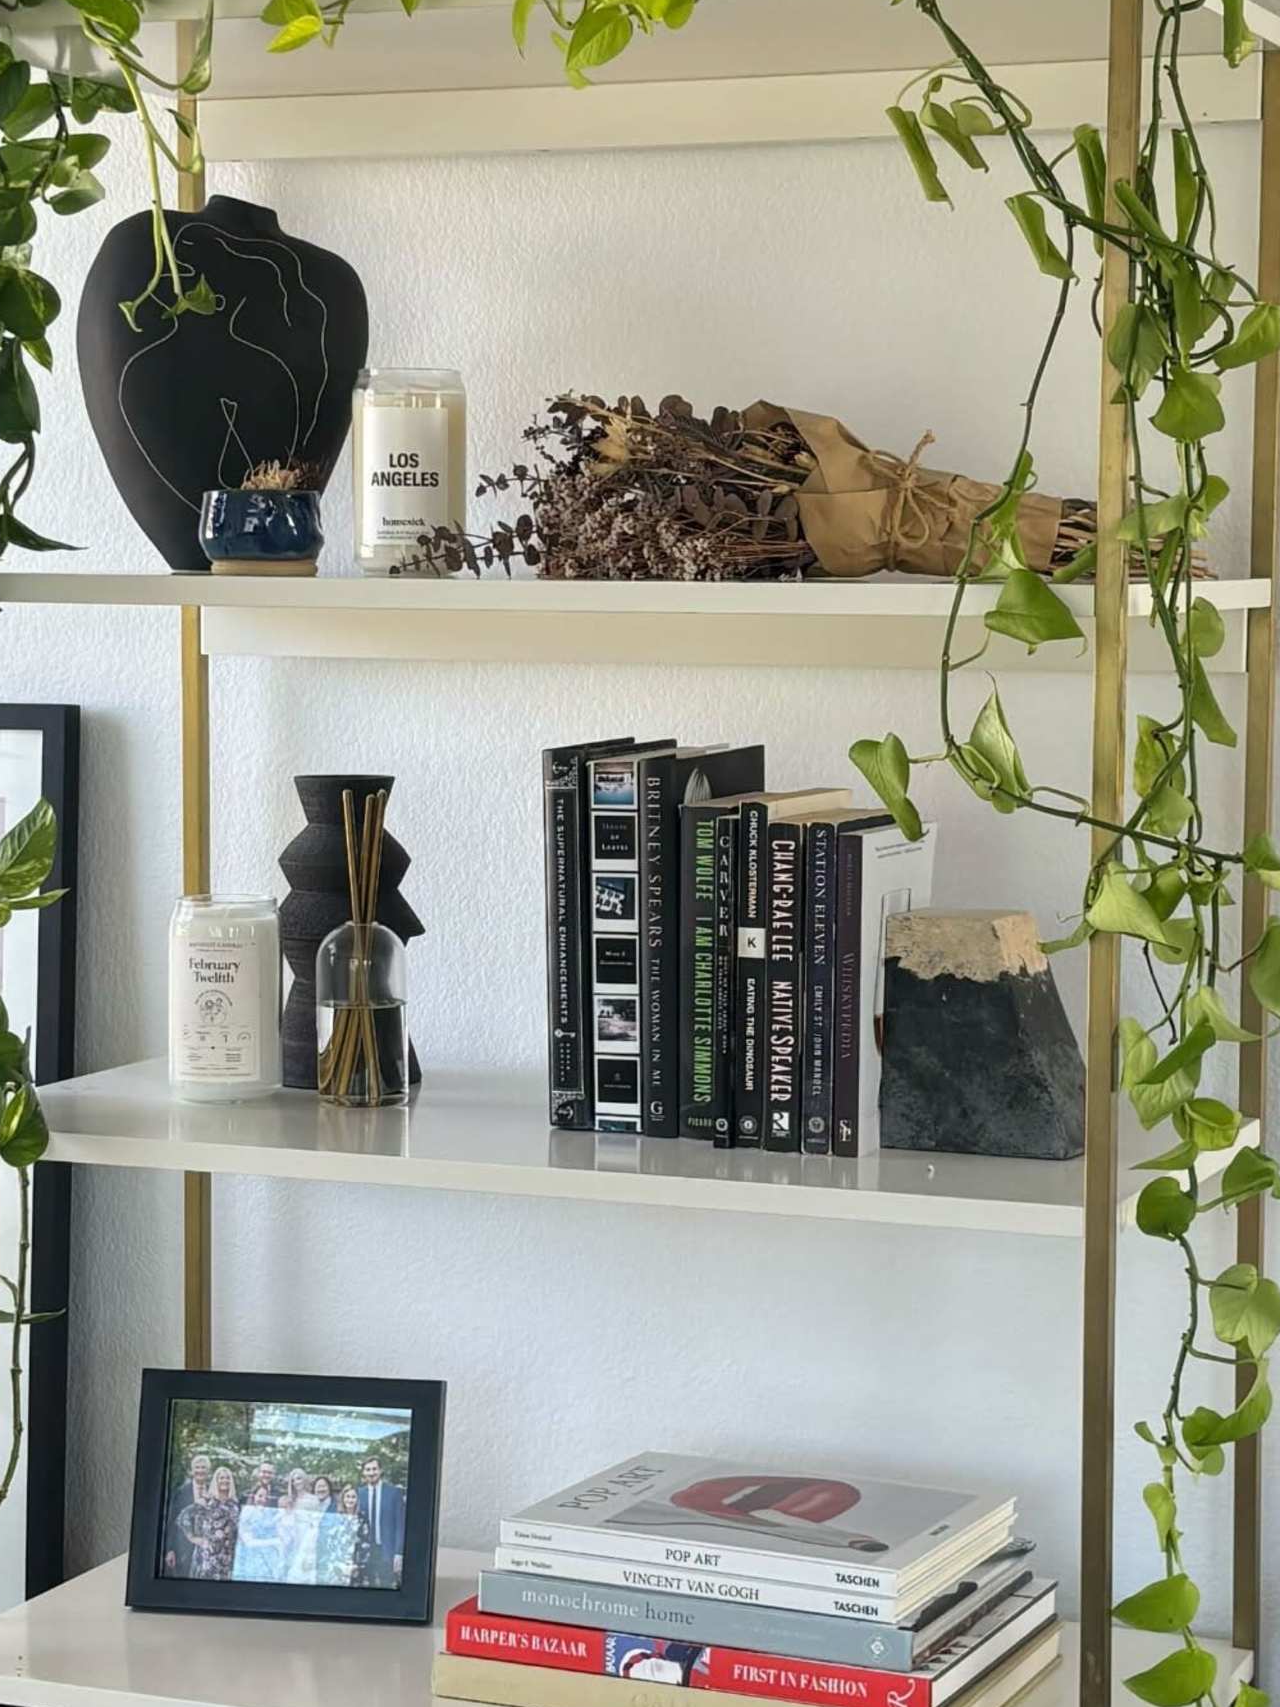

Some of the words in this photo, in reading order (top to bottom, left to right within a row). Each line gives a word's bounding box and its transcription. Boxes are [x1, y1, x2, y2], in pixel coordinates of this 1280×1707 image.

[389, 453, 419, 468] LOS
[371, 472, 439, 487] ANGELES
[556, 798, 564, 821] THE
[647, 777, 661, 865] BRITNEY
[696, 820, 714, 849] TOM
[749, 810, 758, 845] CHUCK
[557, 825, 567, 922] SUPERNATURAL
[696, 856, 714, 900] WOLFE
[814, 829, 826, 897] STATION
[719, 836, 730, 937] CARVER
[748, 850, 758, 918] KLOSTERMAN
[772, 840, 795, 929] CHANG-RAE
[648, 874, 663, 948] SPEARS
[695, 926, 713, 947] AM
[747, 937, 756, 948] K
[771, 935, 793, 961] LEE
[814, 905, 826, 965] ELEVEN
[189, 958, 240, 972] February
[194, 971, 234, 983] Twelfth
[558, 926, 568, 1024] ENHANCEMENTS
[651, 958, 661, 981] THE
[694, 953, 713, 1032] CHARLOTTE
[746, 978, 755, 1014] EATING
[771, 981, 793, 1031] NATIVE
[650, 989, 663, 1042] WOMAN
[746, 1018, 755, 1036] THE
[651, 1049, 661, 1062] IN
[693, 1037, 712, 1103] SIMMONS
[745, 1039, 754, 1091] DINOSAUR
[770, 1035, 794, 1102] SPEAKER
[557, 1485, 617, 1511] POP
[618, 1465, 664, 1489] ART
[665, 1548, 691, 1564] POP
[694, 1550, 721, 1567] ART
[623, 1570, 683, 1590] VINCENT
[687, 1576, 715, 1594] VAN
[717, 1584, 759, 1601] GOGH
[835, 1572, 880, 1588] TASCHEN
[522, 1589, 640, 1618] monochrome
[645, 1600, 696, 1626] home
[833, 1600, 879, 1617] TASCHEN
[532, 1634, 588, 1658] BAZAAR
[733, 1664, 778, 1685] FIRST
[780, 1670, 797, 1688] IN
[799, 1675, 868, 1697] FASHION
